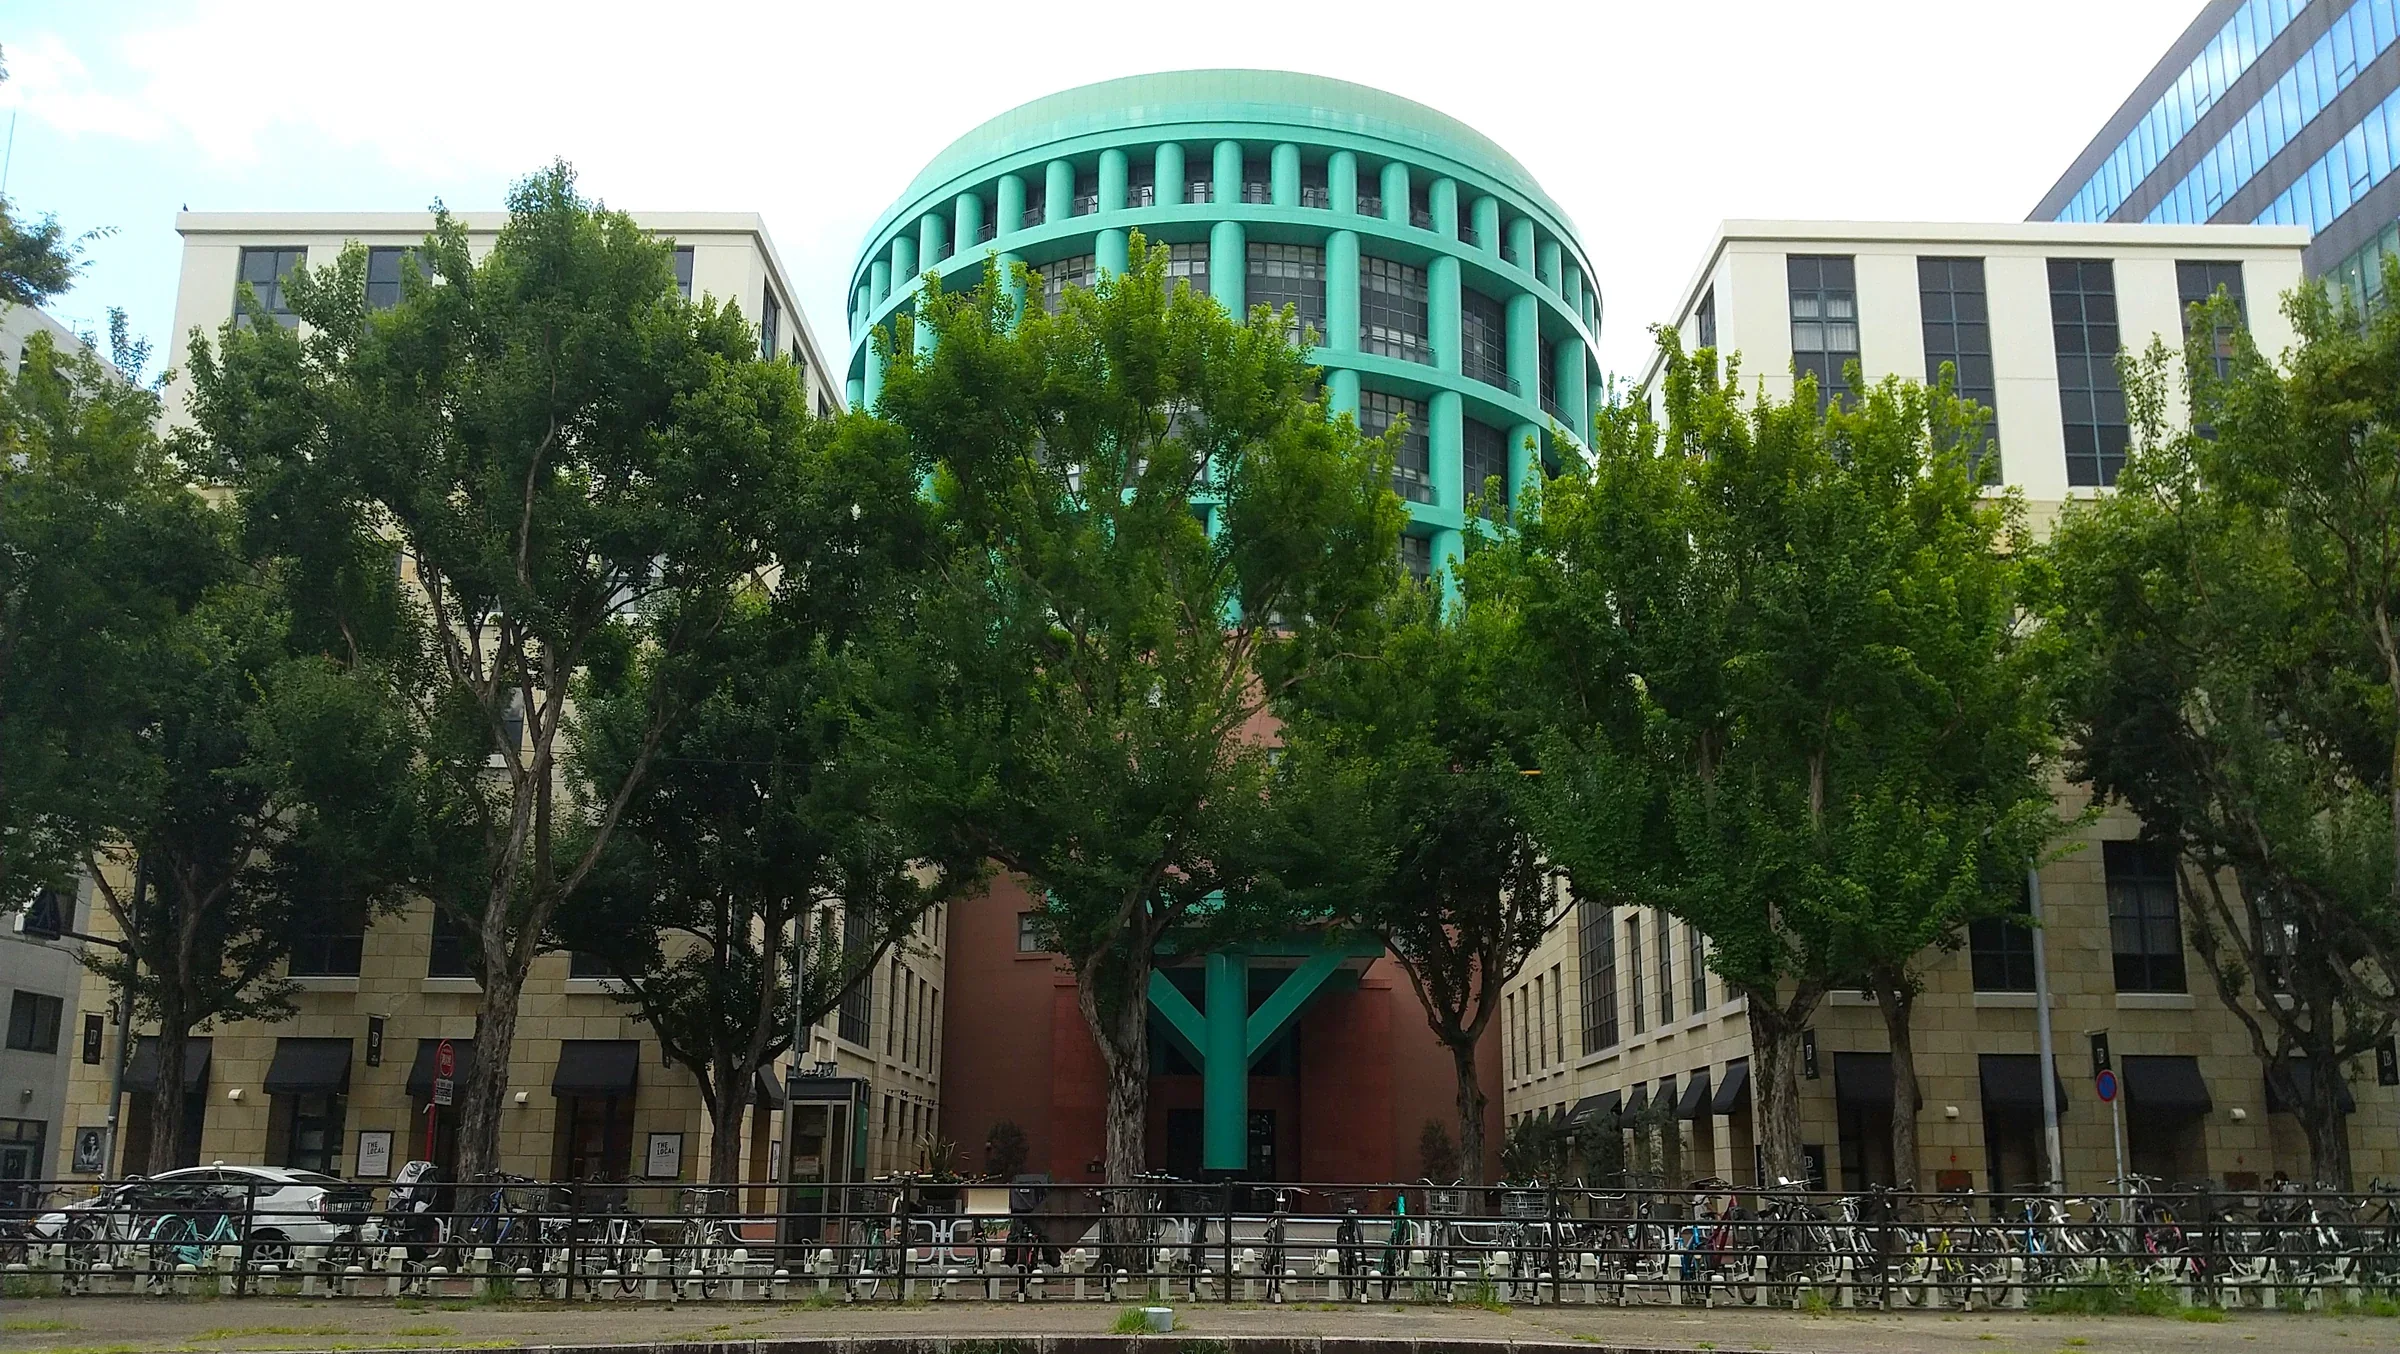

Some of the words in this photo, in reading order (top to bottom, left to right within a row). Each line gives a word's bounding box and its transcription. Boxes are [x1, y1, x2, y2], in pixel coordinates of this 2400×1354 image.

[657, 1141, 668, 1149] THE
[367, 1147, 384, 1155] LOCAL
[657, 1147, 675, 1155] LOCAL
